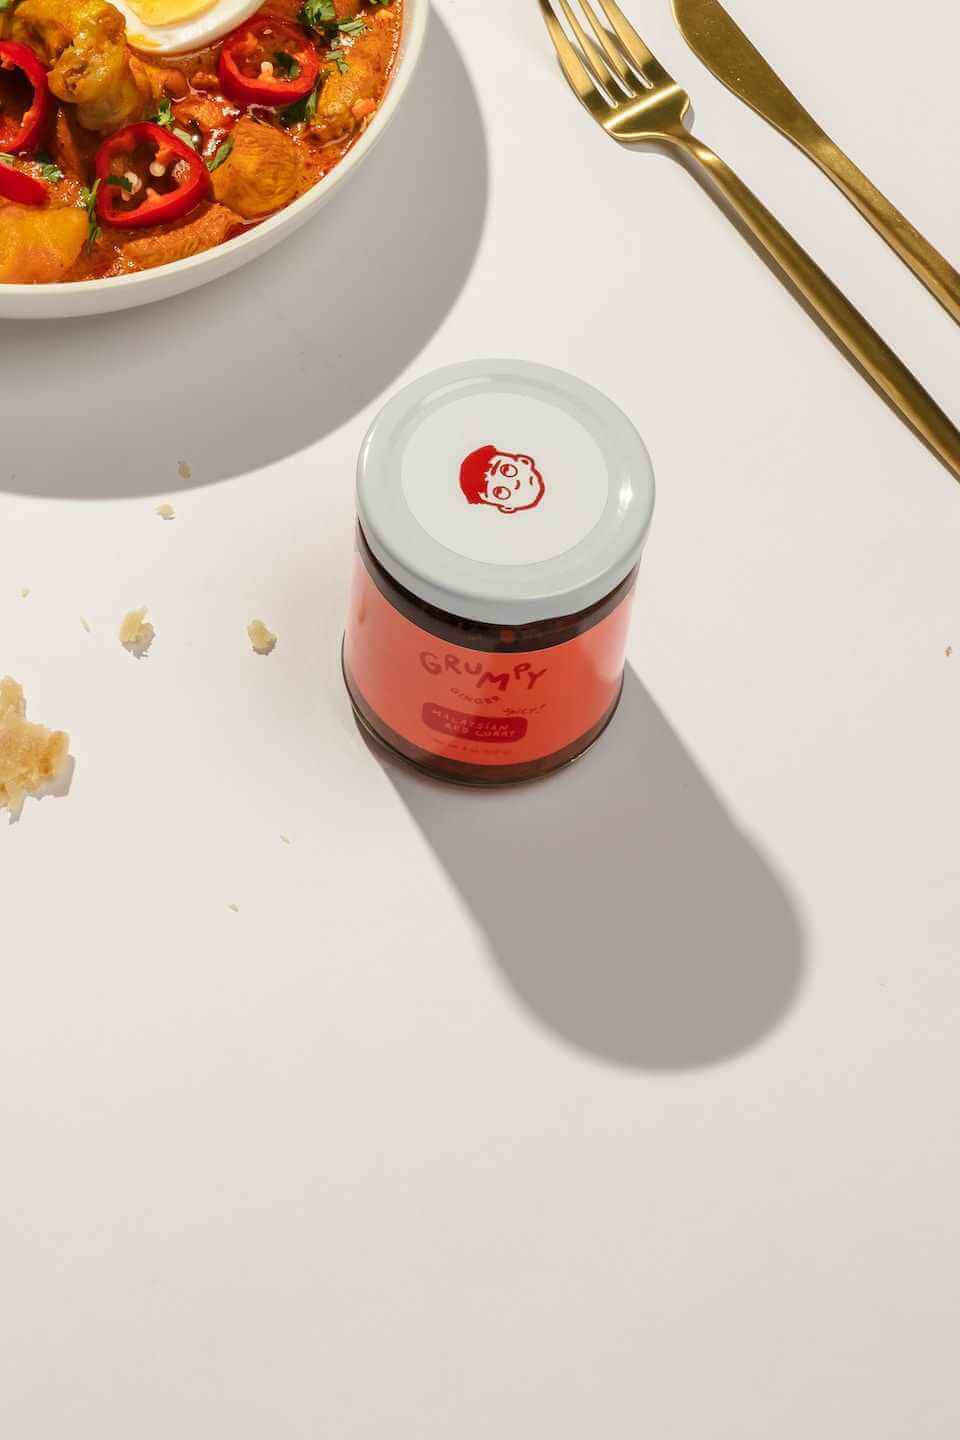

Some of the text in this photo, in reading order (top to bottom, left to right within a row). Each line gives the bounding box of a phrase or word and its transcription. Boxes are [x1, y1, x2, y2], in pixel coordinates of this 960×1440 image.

[419, 652, 548, 691] GRUMPY
[432, 709, 509, 730] MALAYSIAN
[476, 729, 516, 738] CURRY
